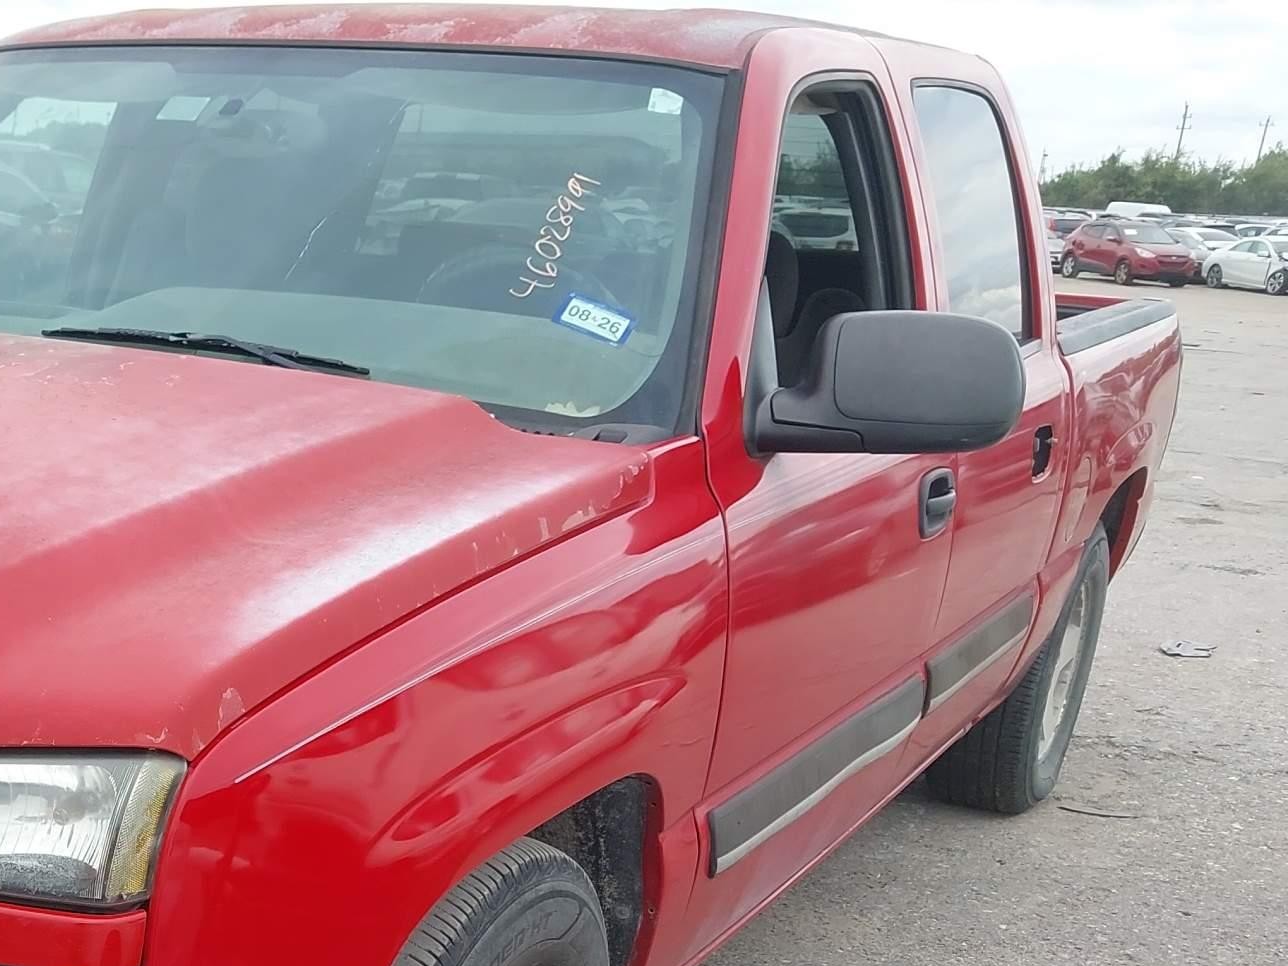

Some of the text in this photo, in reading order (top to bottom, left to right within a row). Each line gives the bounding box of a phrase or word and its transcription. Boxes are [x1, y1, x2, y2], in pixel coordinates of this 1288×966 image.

[509, 172, 601, 297] 46028991
[568, 305, 623, 334] 08 26
